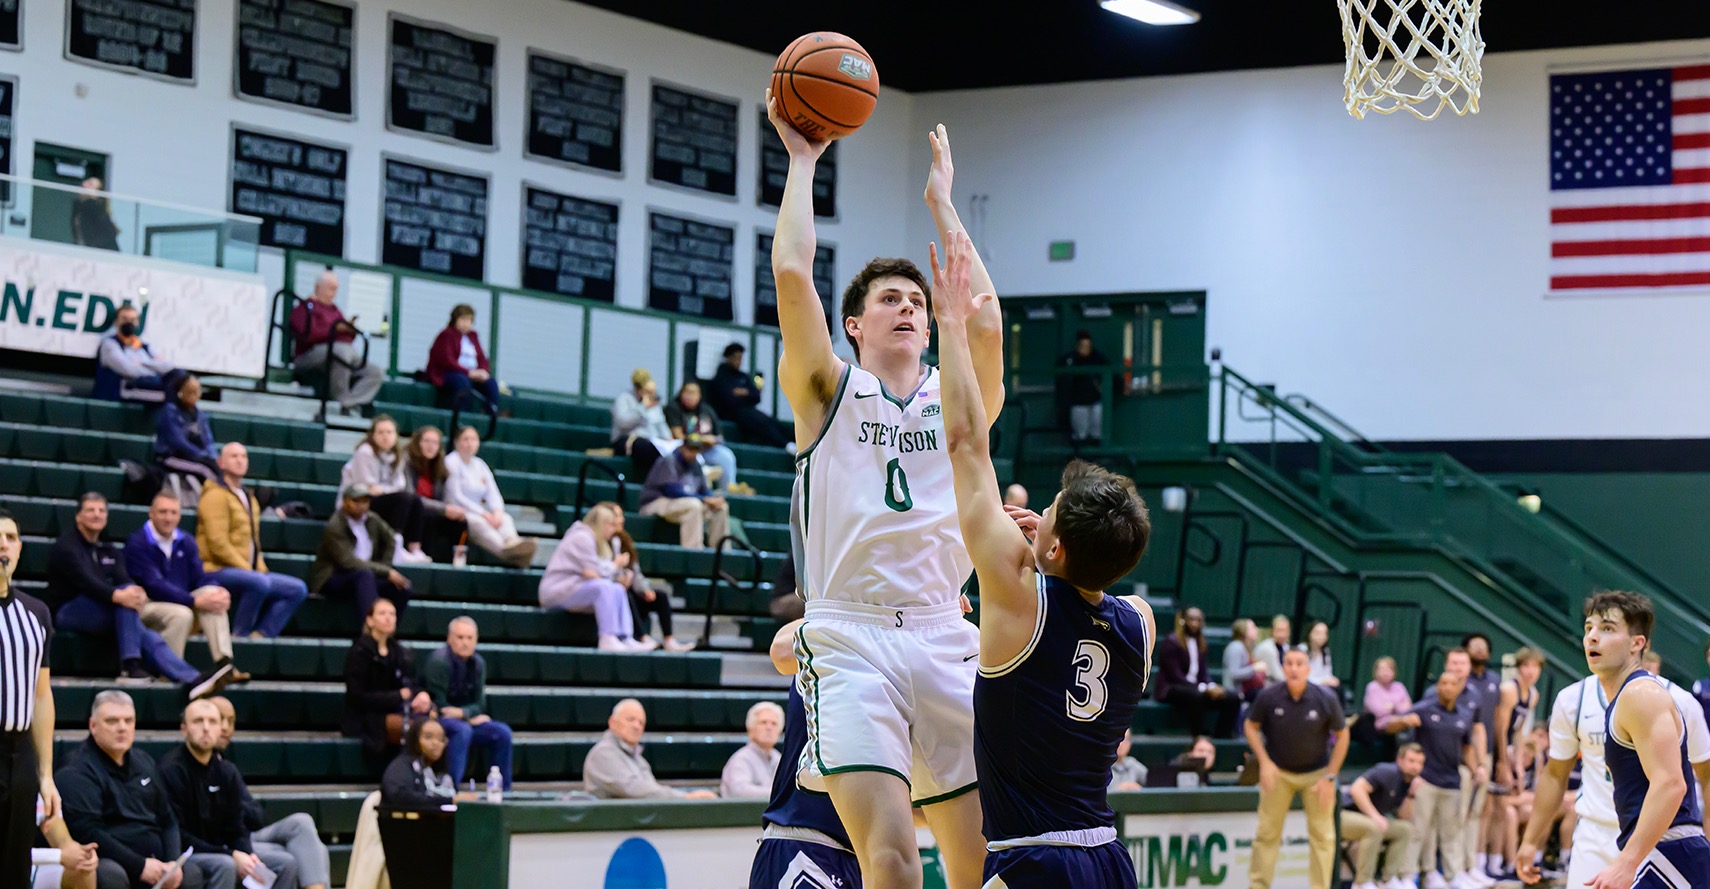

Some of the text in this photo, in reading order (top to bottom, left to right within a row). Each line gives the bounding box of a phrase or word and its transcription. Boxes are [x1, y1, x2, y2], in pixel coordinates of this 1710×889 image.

[842, 55, 871, 73] MAC
[858, 421, 938, 453] STEVSON
[884, 457, 913, 512] 0
[895, 610, 903, 628] S
[1066, 639, 1110, 722] 3
[1148, 832, 1228, 888] MAC
